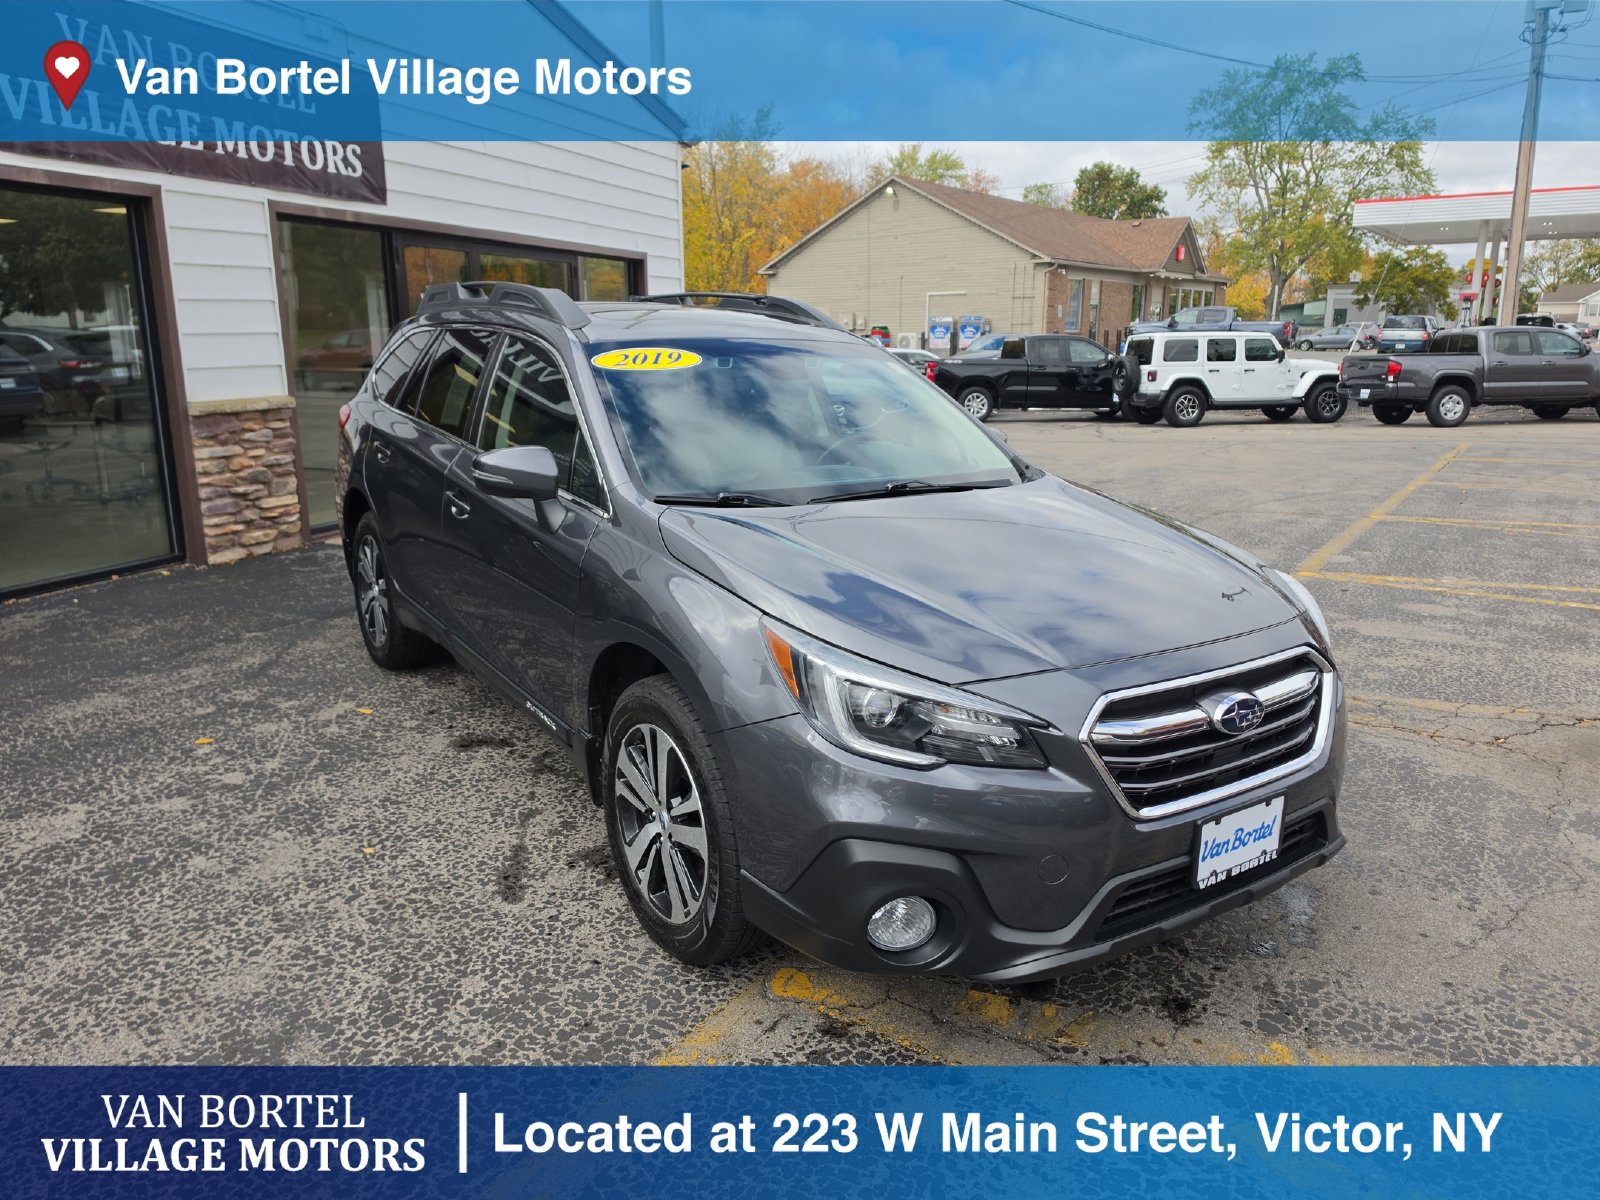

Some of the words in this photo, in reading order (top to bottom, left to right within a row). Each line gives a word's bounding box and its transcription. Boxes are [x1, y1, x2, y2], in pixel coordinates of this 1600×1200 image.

[0, 73, 204, 151] VILLAGE
[211, 116, 363, 178] MOTORS
[613, 352, 682, 367] 2019
[1198, 870, 1227, 890] VAN
[1231, 850, 1278, 877] BORTEL
